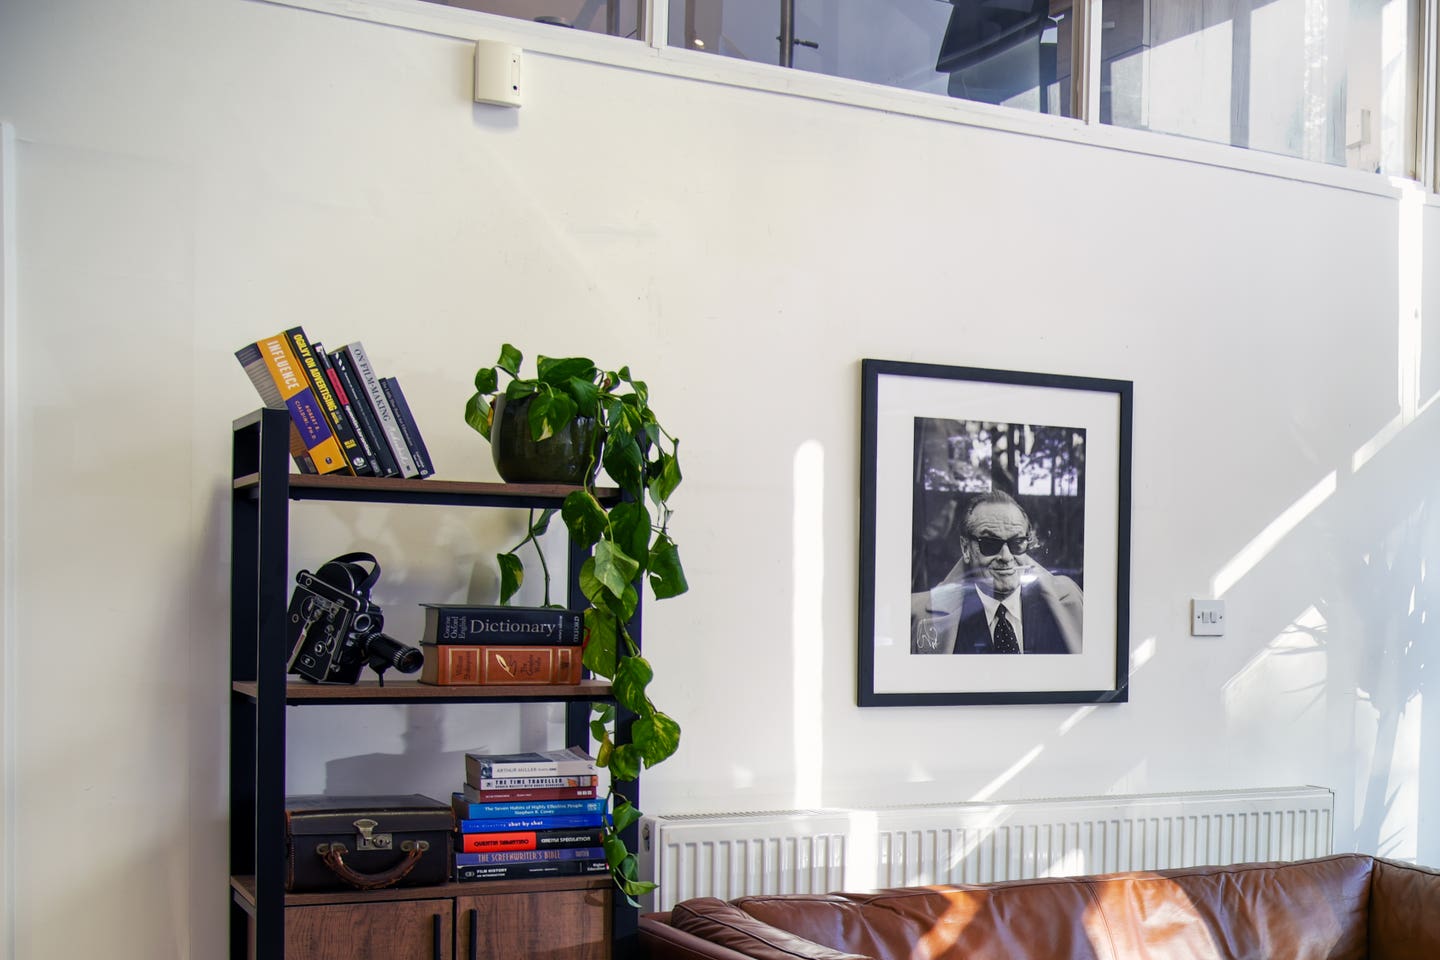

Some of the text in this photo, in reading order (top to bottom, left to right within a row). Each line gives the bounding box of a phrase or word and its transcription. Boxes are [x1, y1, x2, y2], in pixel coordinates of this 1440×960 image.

[293, 334, 311, 359] OGILVY
[267, 340, 300, 390] INFLUENCE
[304, 357, 316, 369] ON
[354, 349, 365, 364] ON
[309, 368, 338, 411] ADVERTISING
[305, 404, 317, 424] ROBERT
[470, 619, 556, 637] Dictionary
[478, 849, 560, 862] THE SCREENWRITER'S BIBLE
